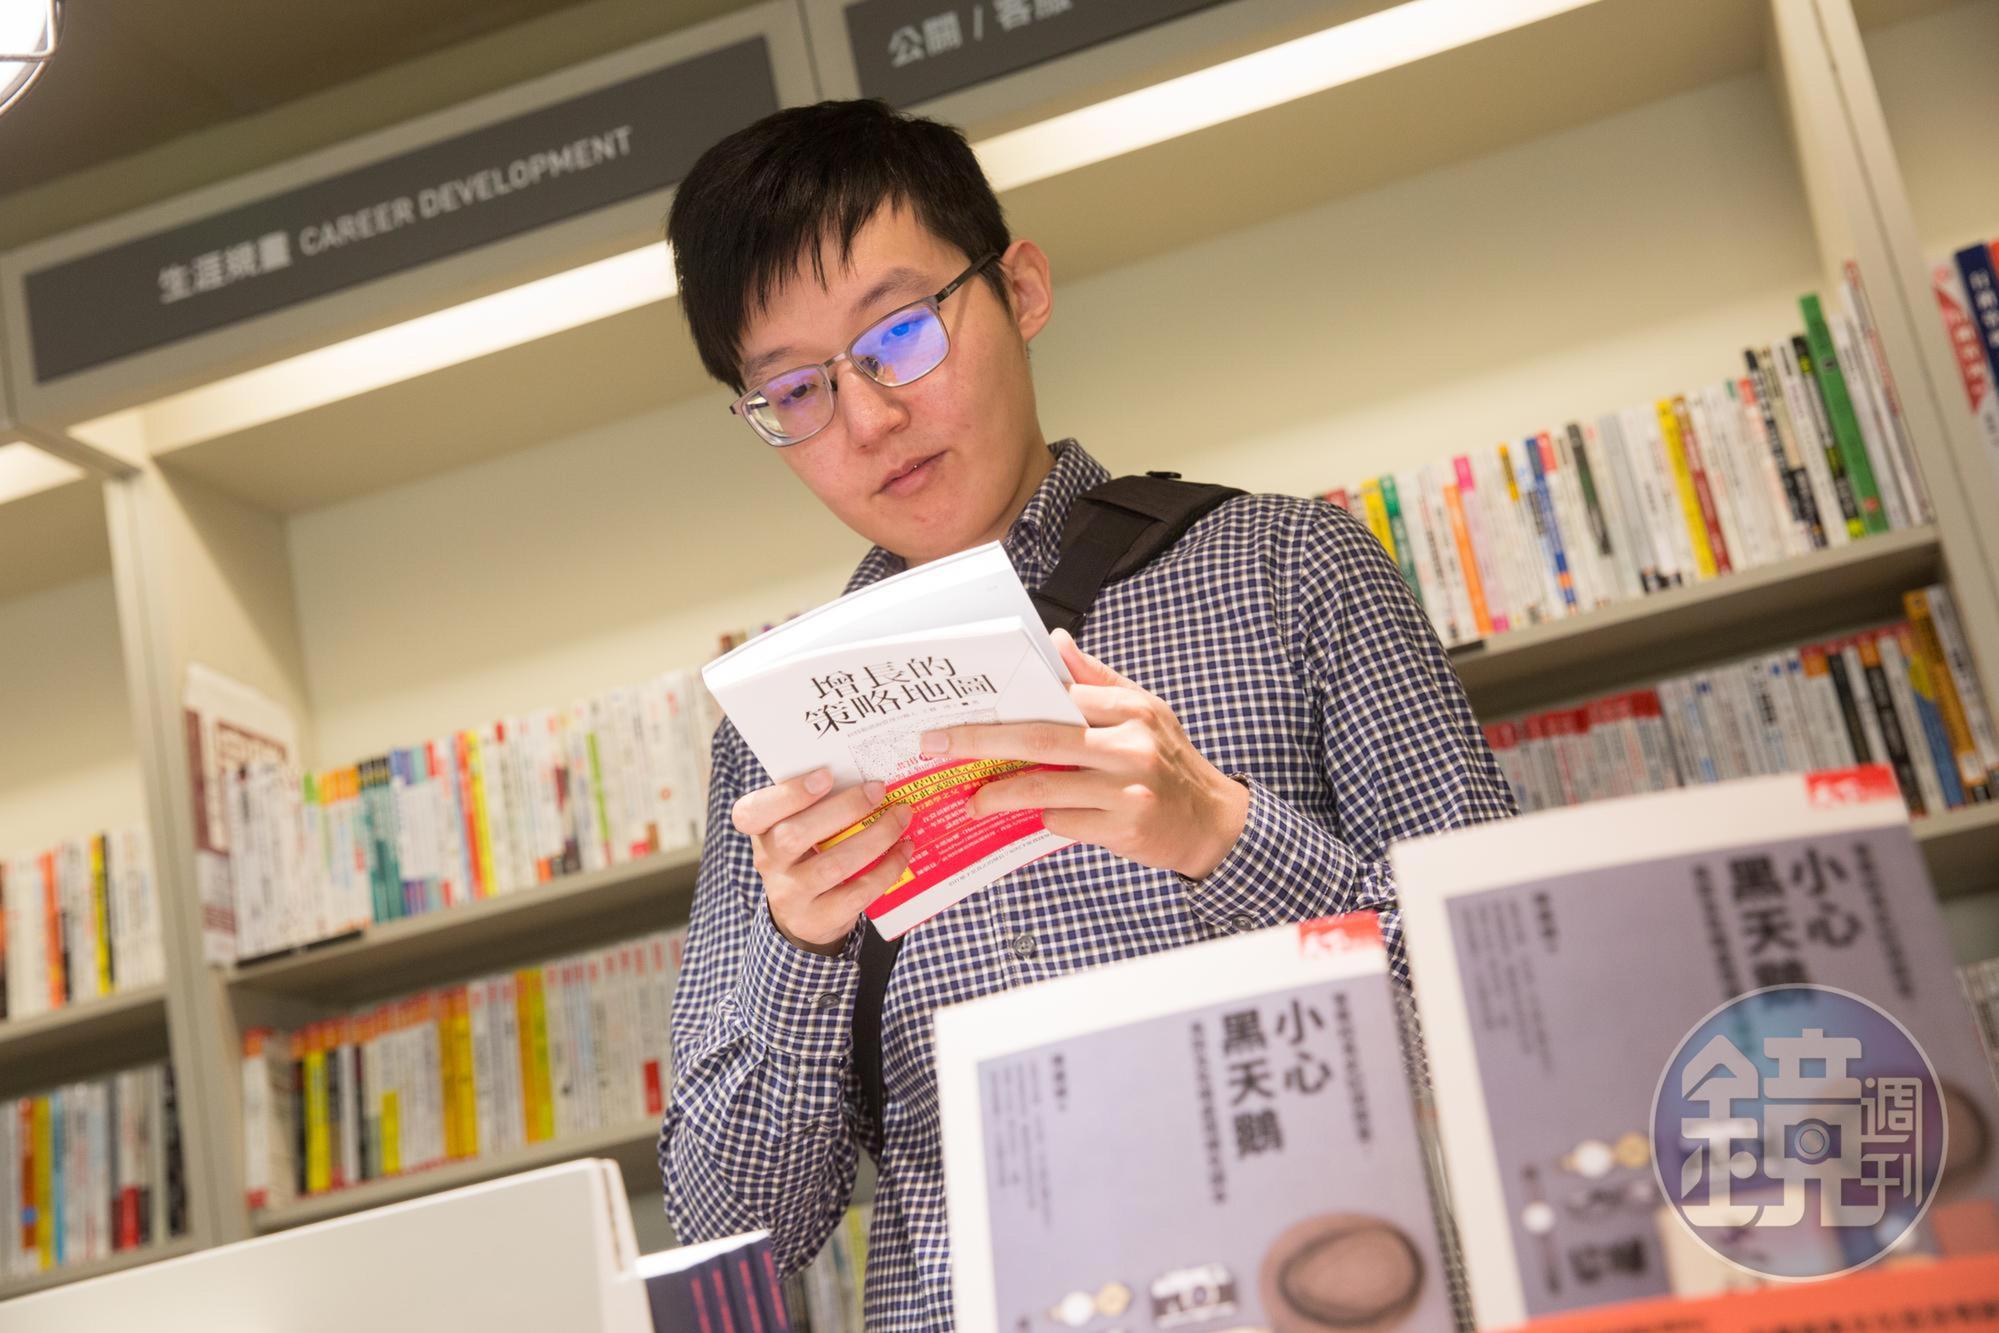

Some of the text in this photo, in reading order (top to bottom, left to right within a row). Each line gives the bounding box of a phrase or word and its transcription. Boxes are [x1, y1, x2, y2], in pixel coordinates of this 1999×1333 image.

[299, 125, 633, 256] CAREER DEVELOPMENT
[805, 674, 998, 740] 策略地圖
[811, 656, 957, 699] 增長的
[1792, 846, 1863, 948] 小心
[1222, 1008, 1285, 1162] 黑天鵝
[1275, 997, 1332, 1094] 小心
